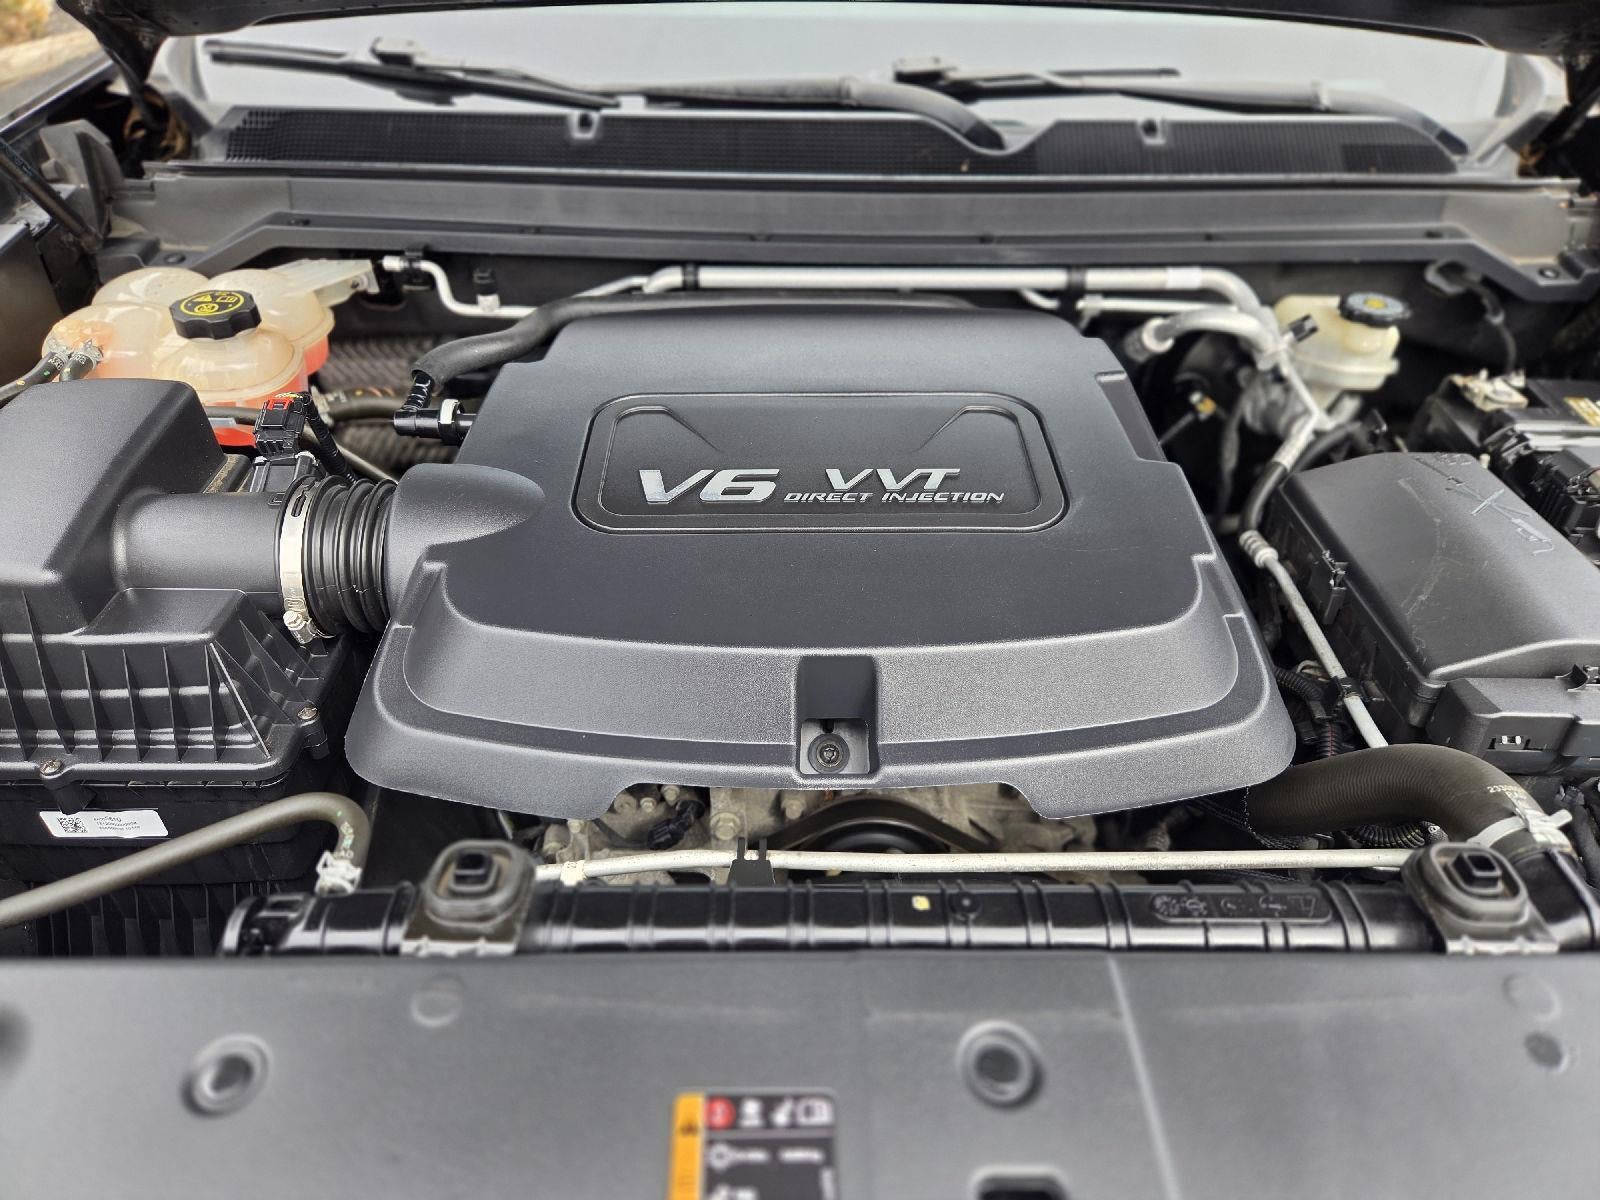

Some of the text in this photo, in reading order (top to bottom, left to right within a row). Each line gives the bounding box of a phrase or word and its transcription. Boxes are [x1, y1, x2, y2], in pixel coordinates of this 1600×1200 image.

[639, 468, 961, 504] V6 VVT
[784, 492, 1005, 503] DIRECT INJECTION
